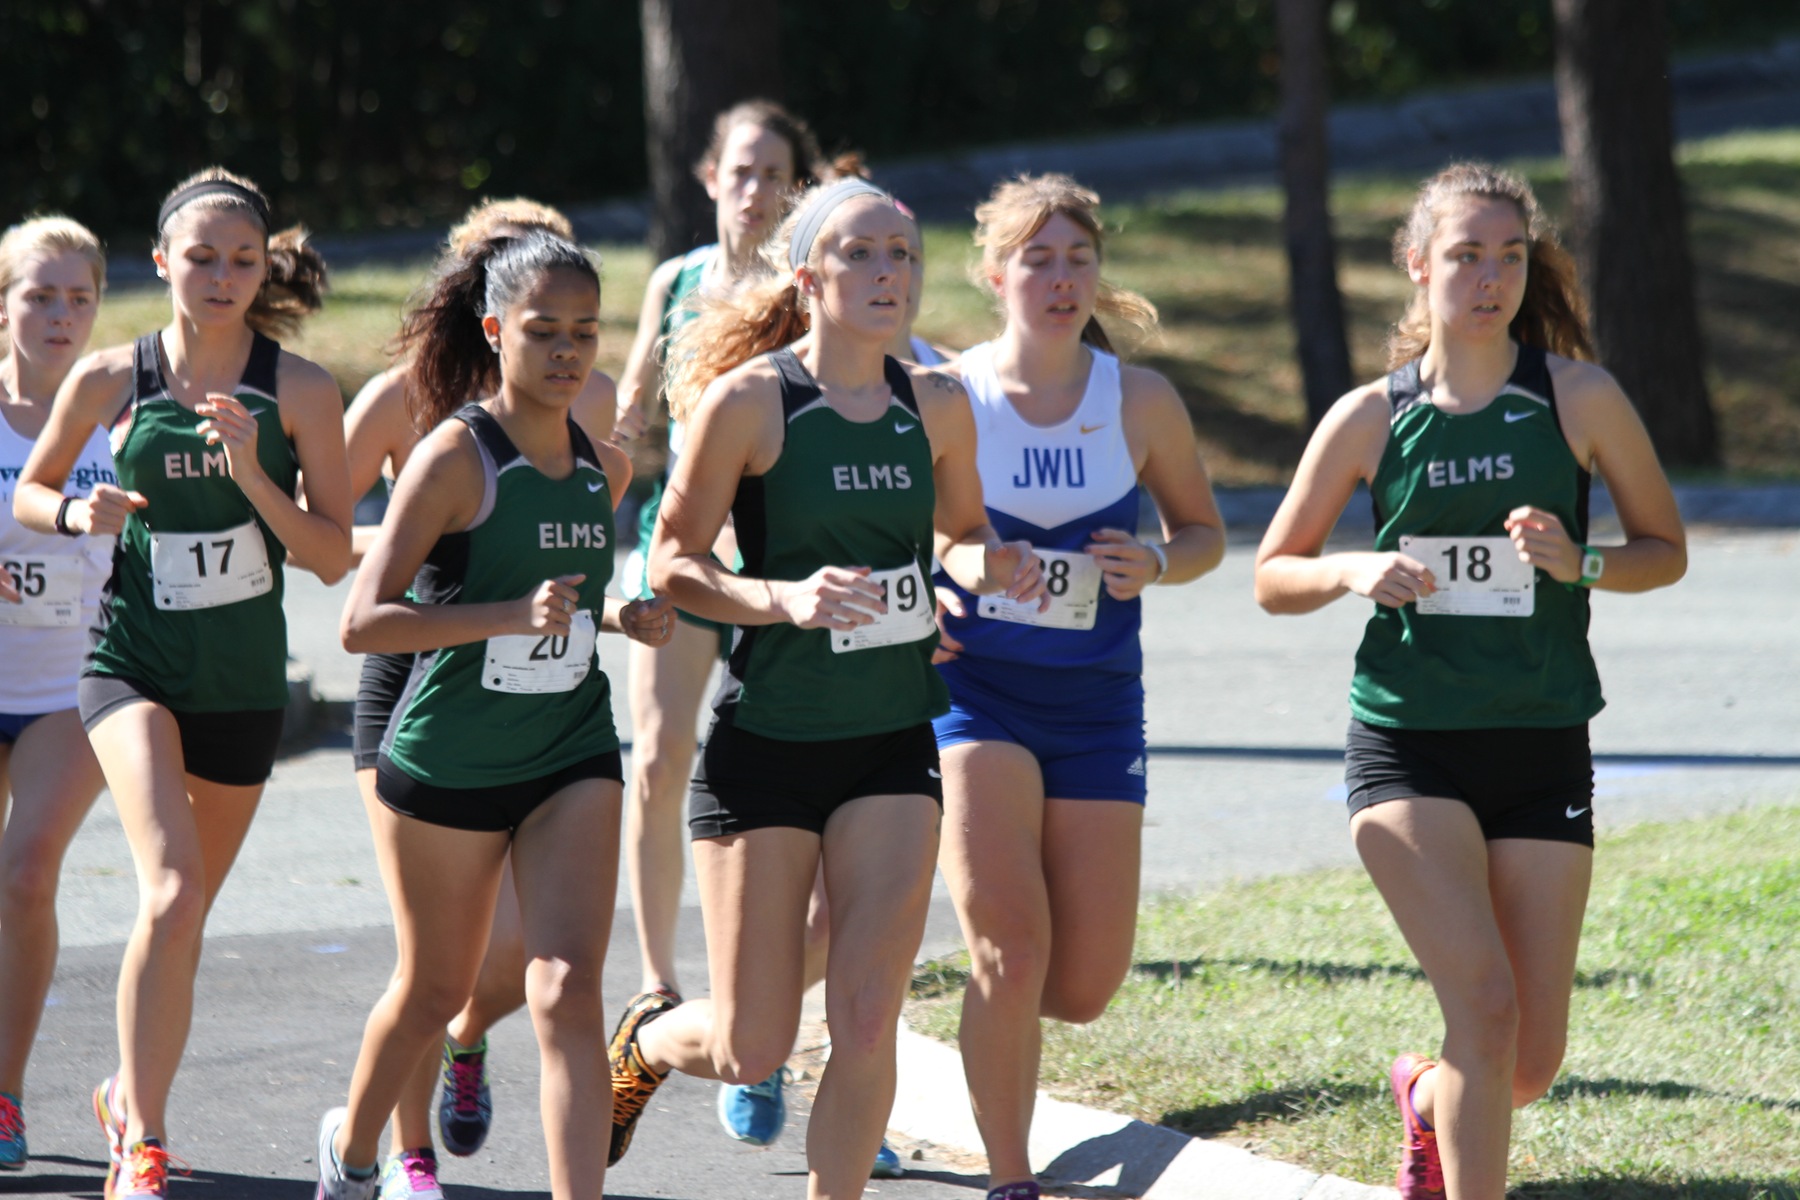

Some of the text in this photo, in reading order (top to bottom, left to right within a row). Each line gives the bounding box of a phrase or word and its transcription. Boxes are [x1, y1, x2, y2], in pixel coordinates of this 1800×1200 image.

[164, 452, 226, 479] ELM
[833, 464, 912, 491] ELMS
[1013, 448, 1085, 488] JWU
[1427, 454, 1515, 488] ELMS
[538, 523, 607, 549] ELMS
[189, 538, 234, 577] 17
[1441, 545, 1492, 582] 18
[1039, 558, 1070, 597] 8
